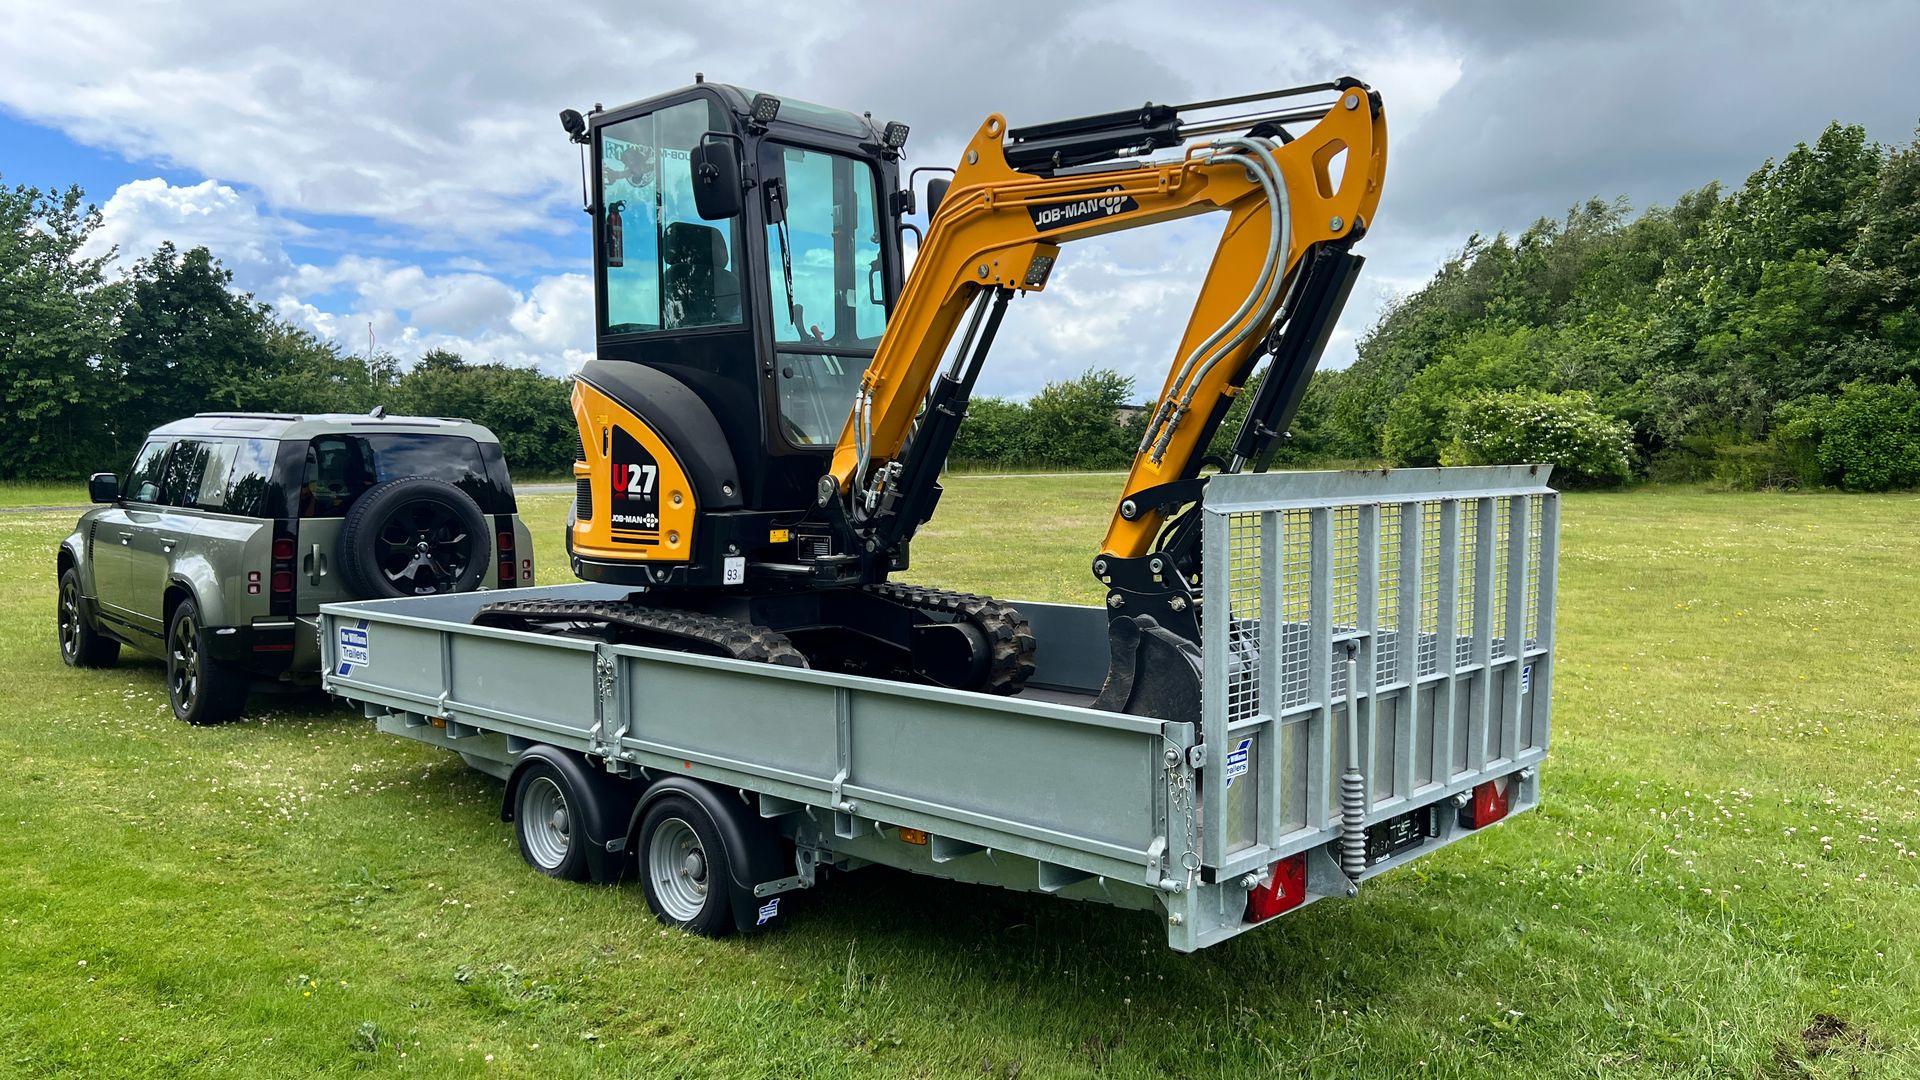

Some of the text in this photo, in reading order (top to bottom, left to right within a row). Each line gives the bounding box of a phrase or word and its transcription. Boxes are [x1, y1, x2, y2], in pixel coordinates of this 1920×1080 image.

[1035, 199, 1099, 226] JOB-MAN
[613, 464, 657, 494] U27
[611, 514, 643, 524] JOB-MAN
[727, 568, 738, 581] 93
[342, 646, 368, 661] Trailers
[1227, 763, 1247, 775] railers
